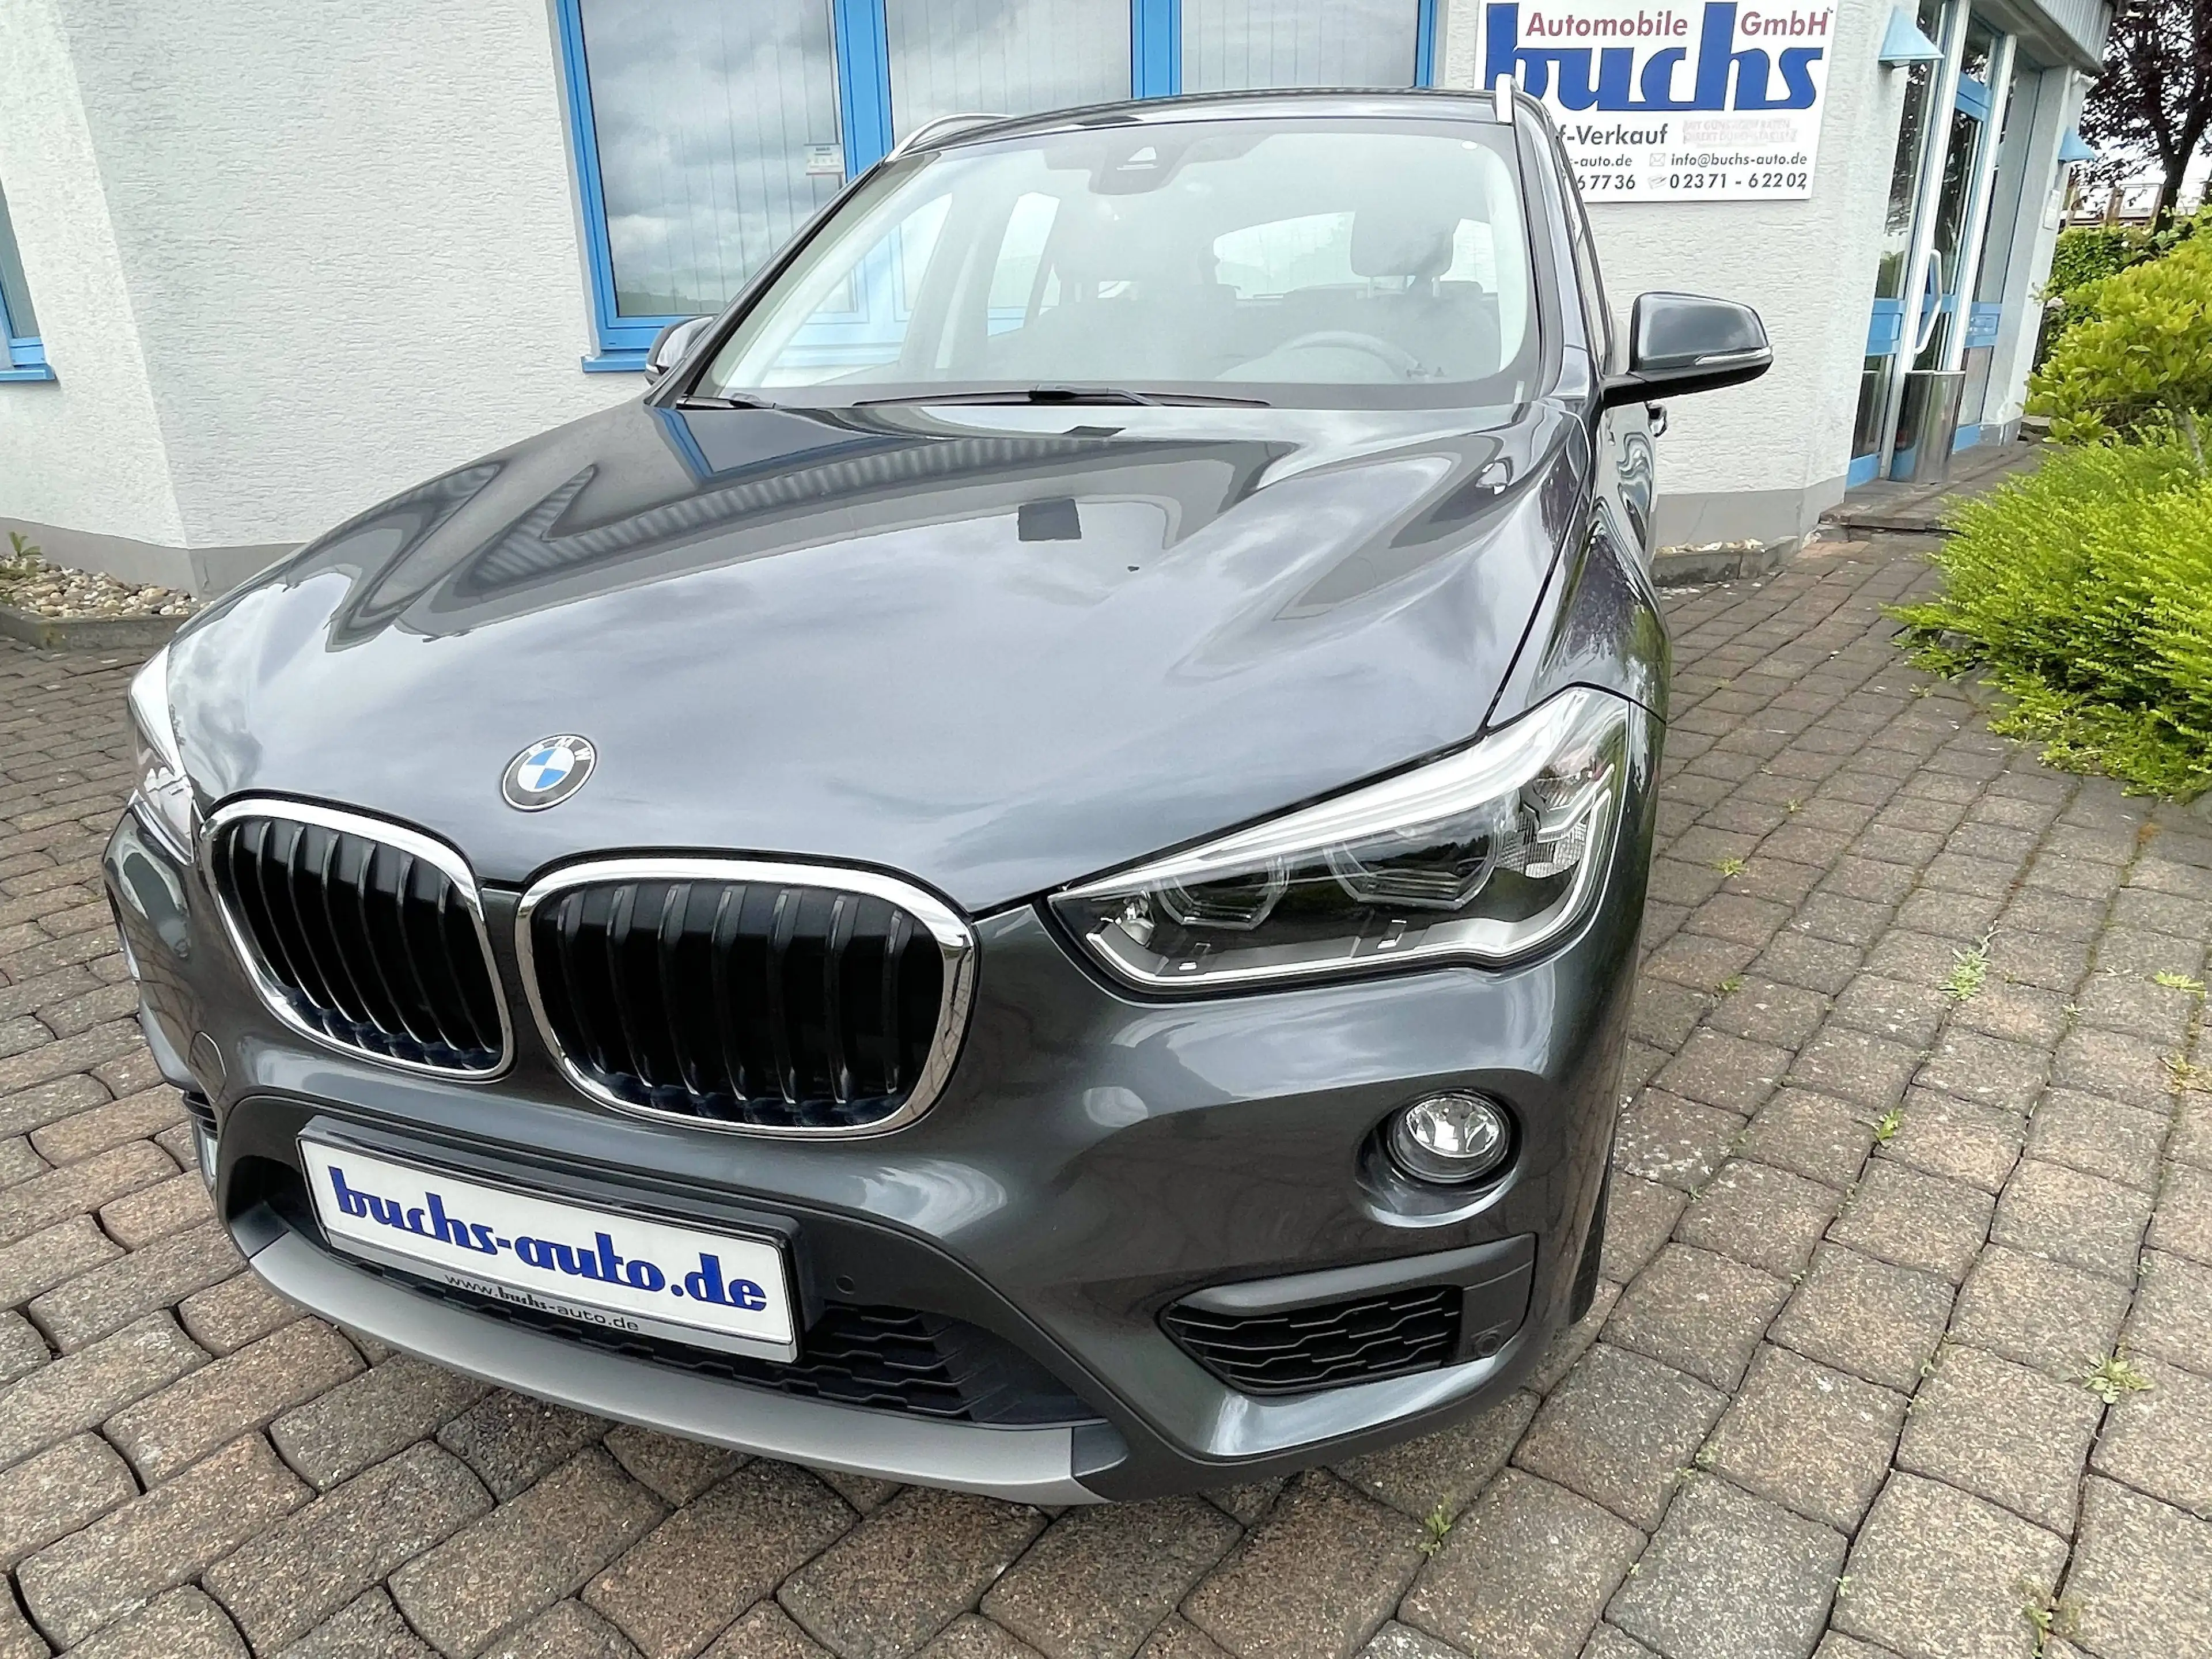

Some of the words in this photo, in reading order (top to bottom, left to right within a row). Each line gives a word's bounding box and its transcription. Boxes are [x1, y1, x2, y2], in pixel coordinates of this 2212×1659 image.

[1526, 11, 1688, 36] Automobile
[1741, 10, 1828, 36] GmbH
[1484, 2, 1824, 111] buchs
[1570, 154, 1633, 167] -auto.de
[1671, 152, 1807, 168] info@buchs-auto.de
[1748, 172, 1808, 189] 62202
[328, 1165, 767, 1312] buchs-auto.de
[444, 1274, 639, 1331] www.buchs-auto.de
